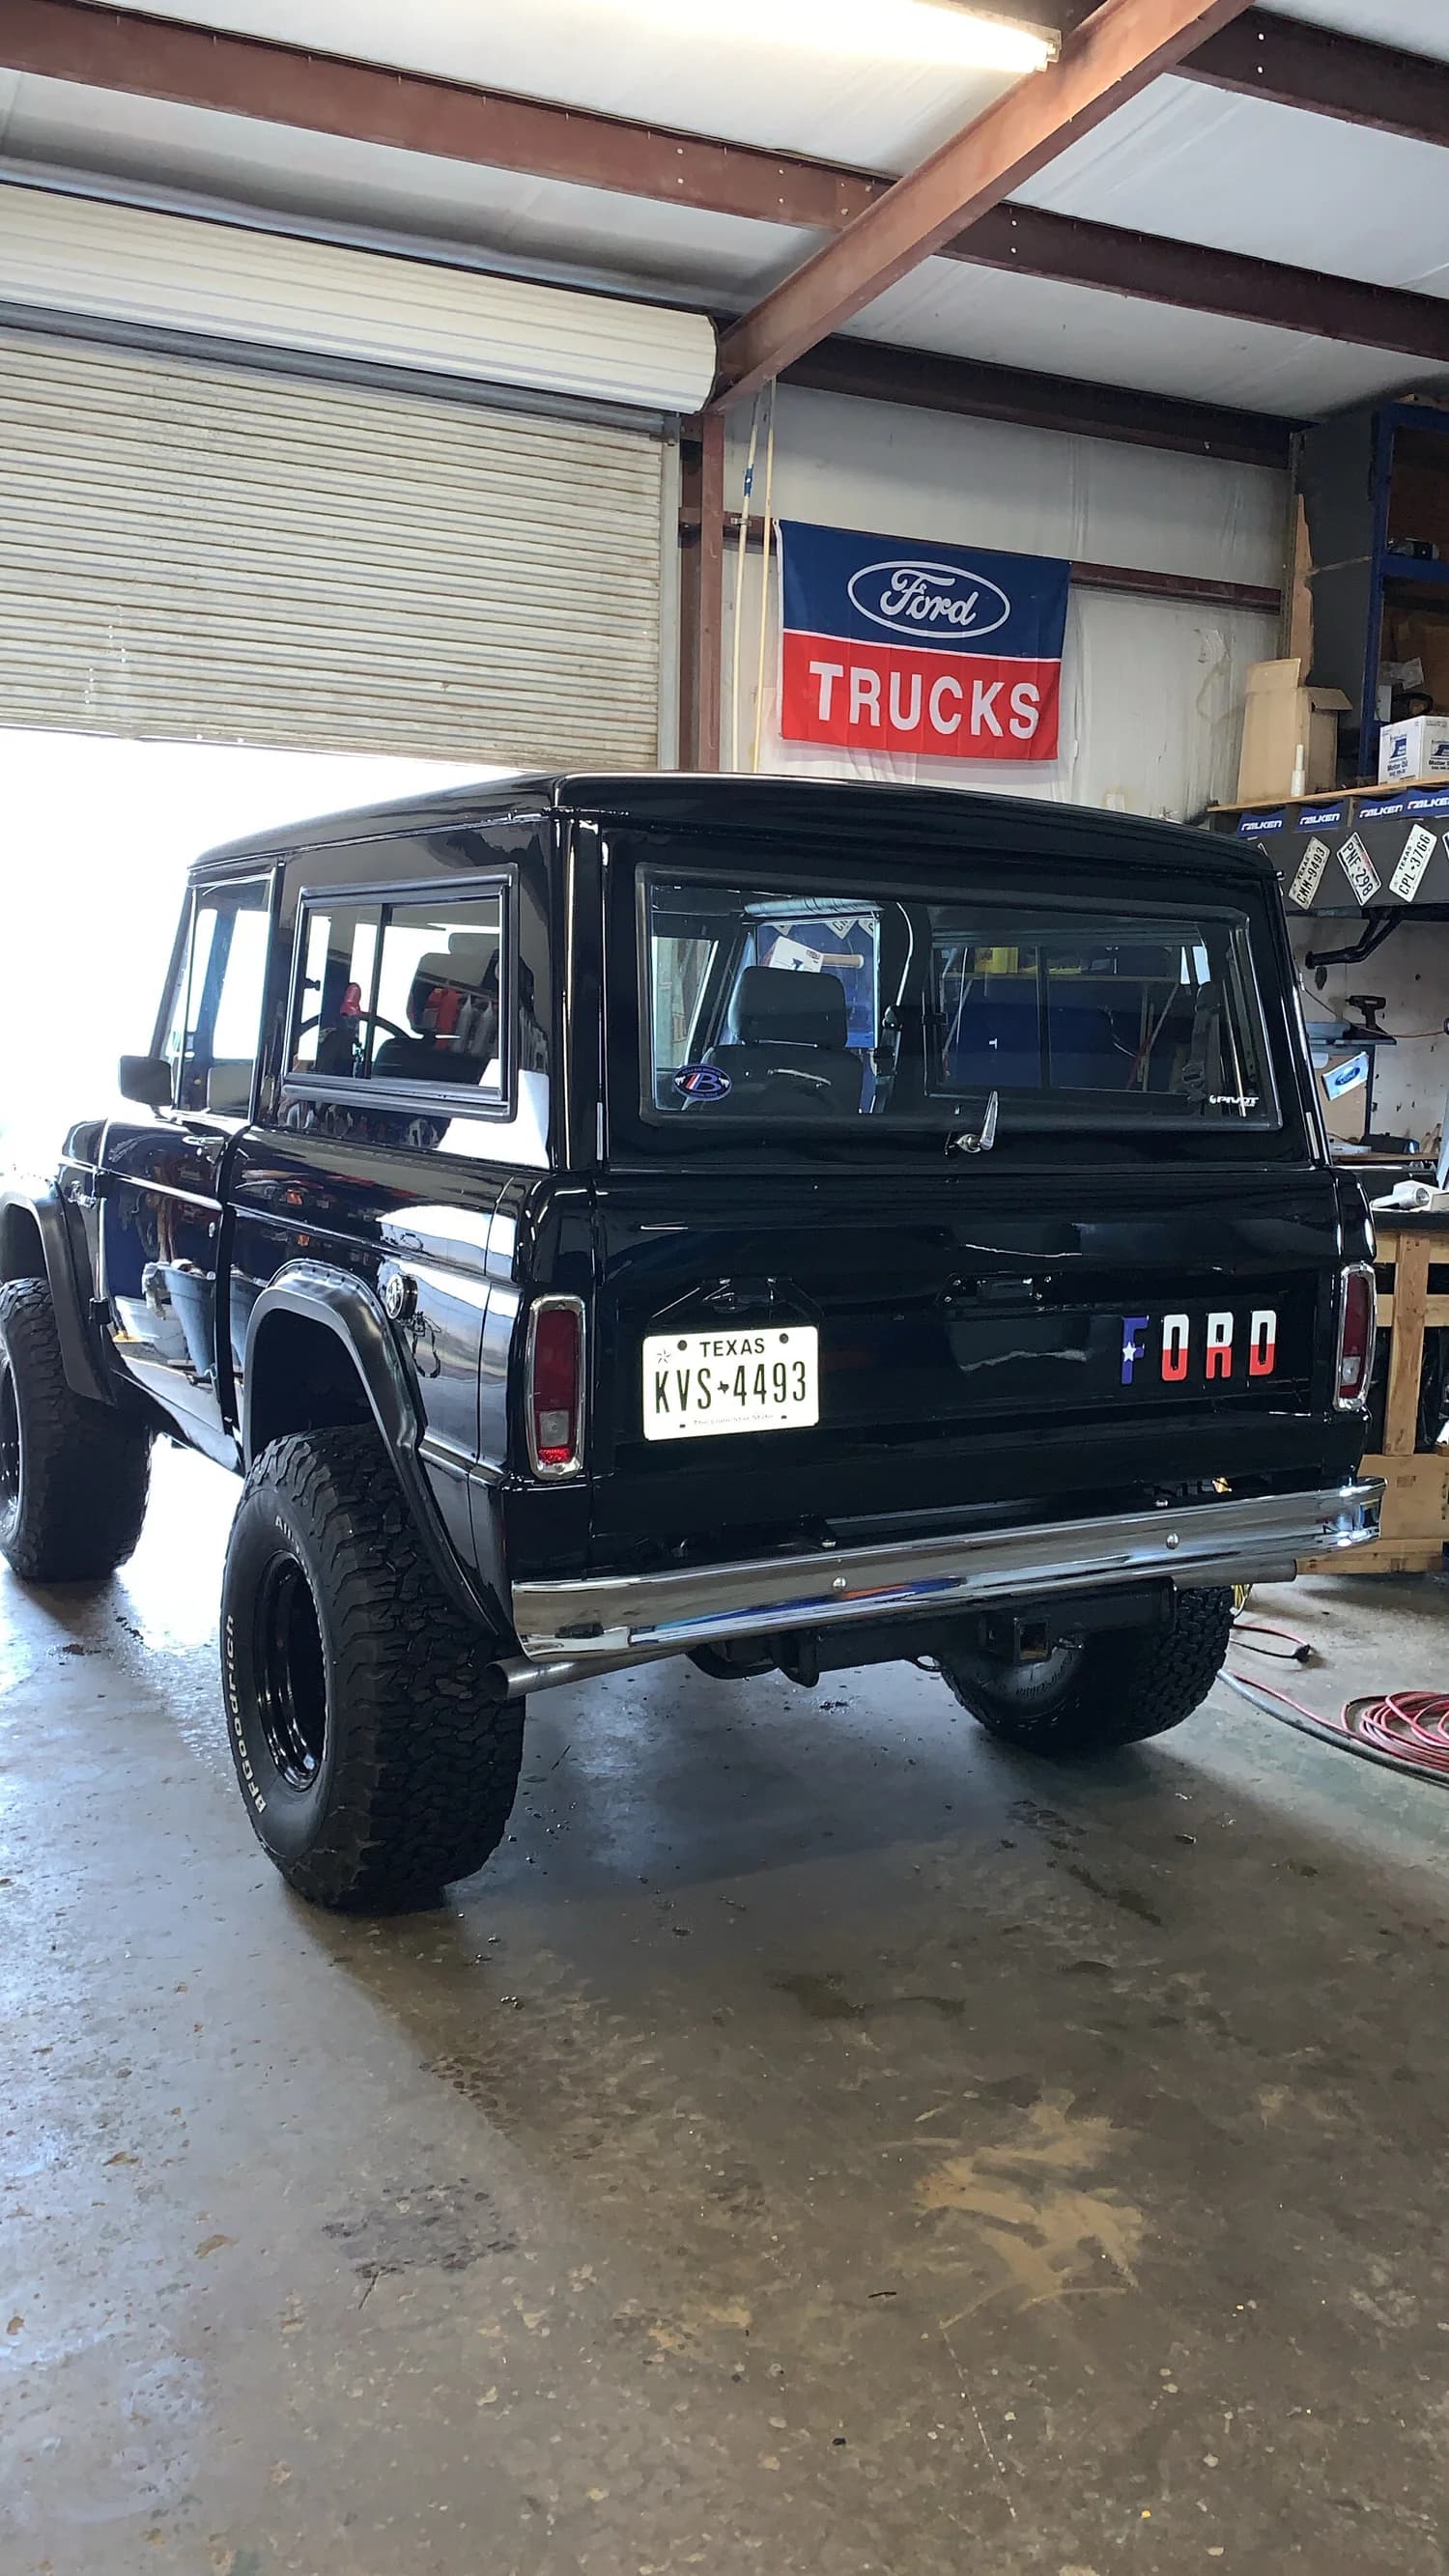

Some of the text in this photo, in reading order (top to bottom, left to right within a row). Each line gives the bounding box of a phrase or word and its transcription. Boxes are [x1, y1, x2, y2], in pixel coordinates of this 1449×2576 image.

[879, 568, 980, 626] Ford
[809, 660, 1040, 740] TRUCKS
[1359, 804, 1404, 818] FALKEN
[1406, 797, 1449, 809] FALKE
[1240, 820, 1283, 832] FALKEN
[1298, 812, 1341, 825] FALKEN
[1399, 845, 1412, 871] TEXAS
[699, 1338, 765, 1357] TEXAS
[1121, 1310, 1277, 1385] FORD
[226, 1614, 268, 1814] BFGoodrich
